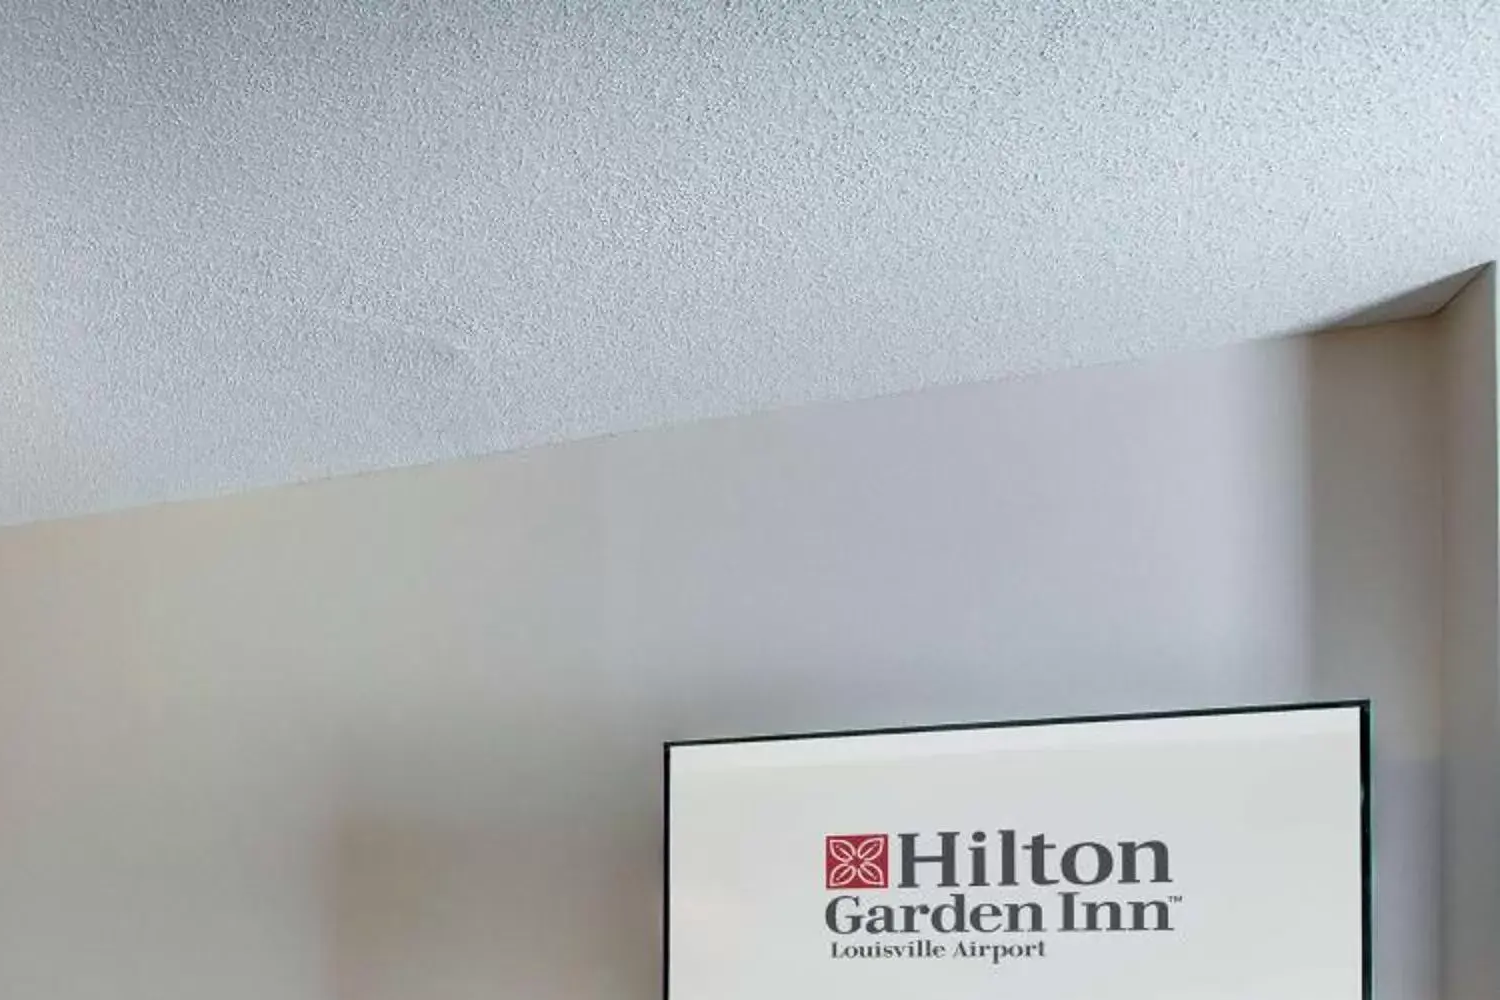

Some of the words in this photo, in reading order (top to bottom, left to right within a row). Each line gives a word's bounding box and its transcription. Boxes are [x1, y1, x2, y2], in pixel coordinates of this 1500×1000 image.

[897, 829, 1174, 889] Hilton
[824, 892, 1047, 935] Garden
[830, 939, 946, 959] Louisville
[953, 939, 1046, 965] Airport
